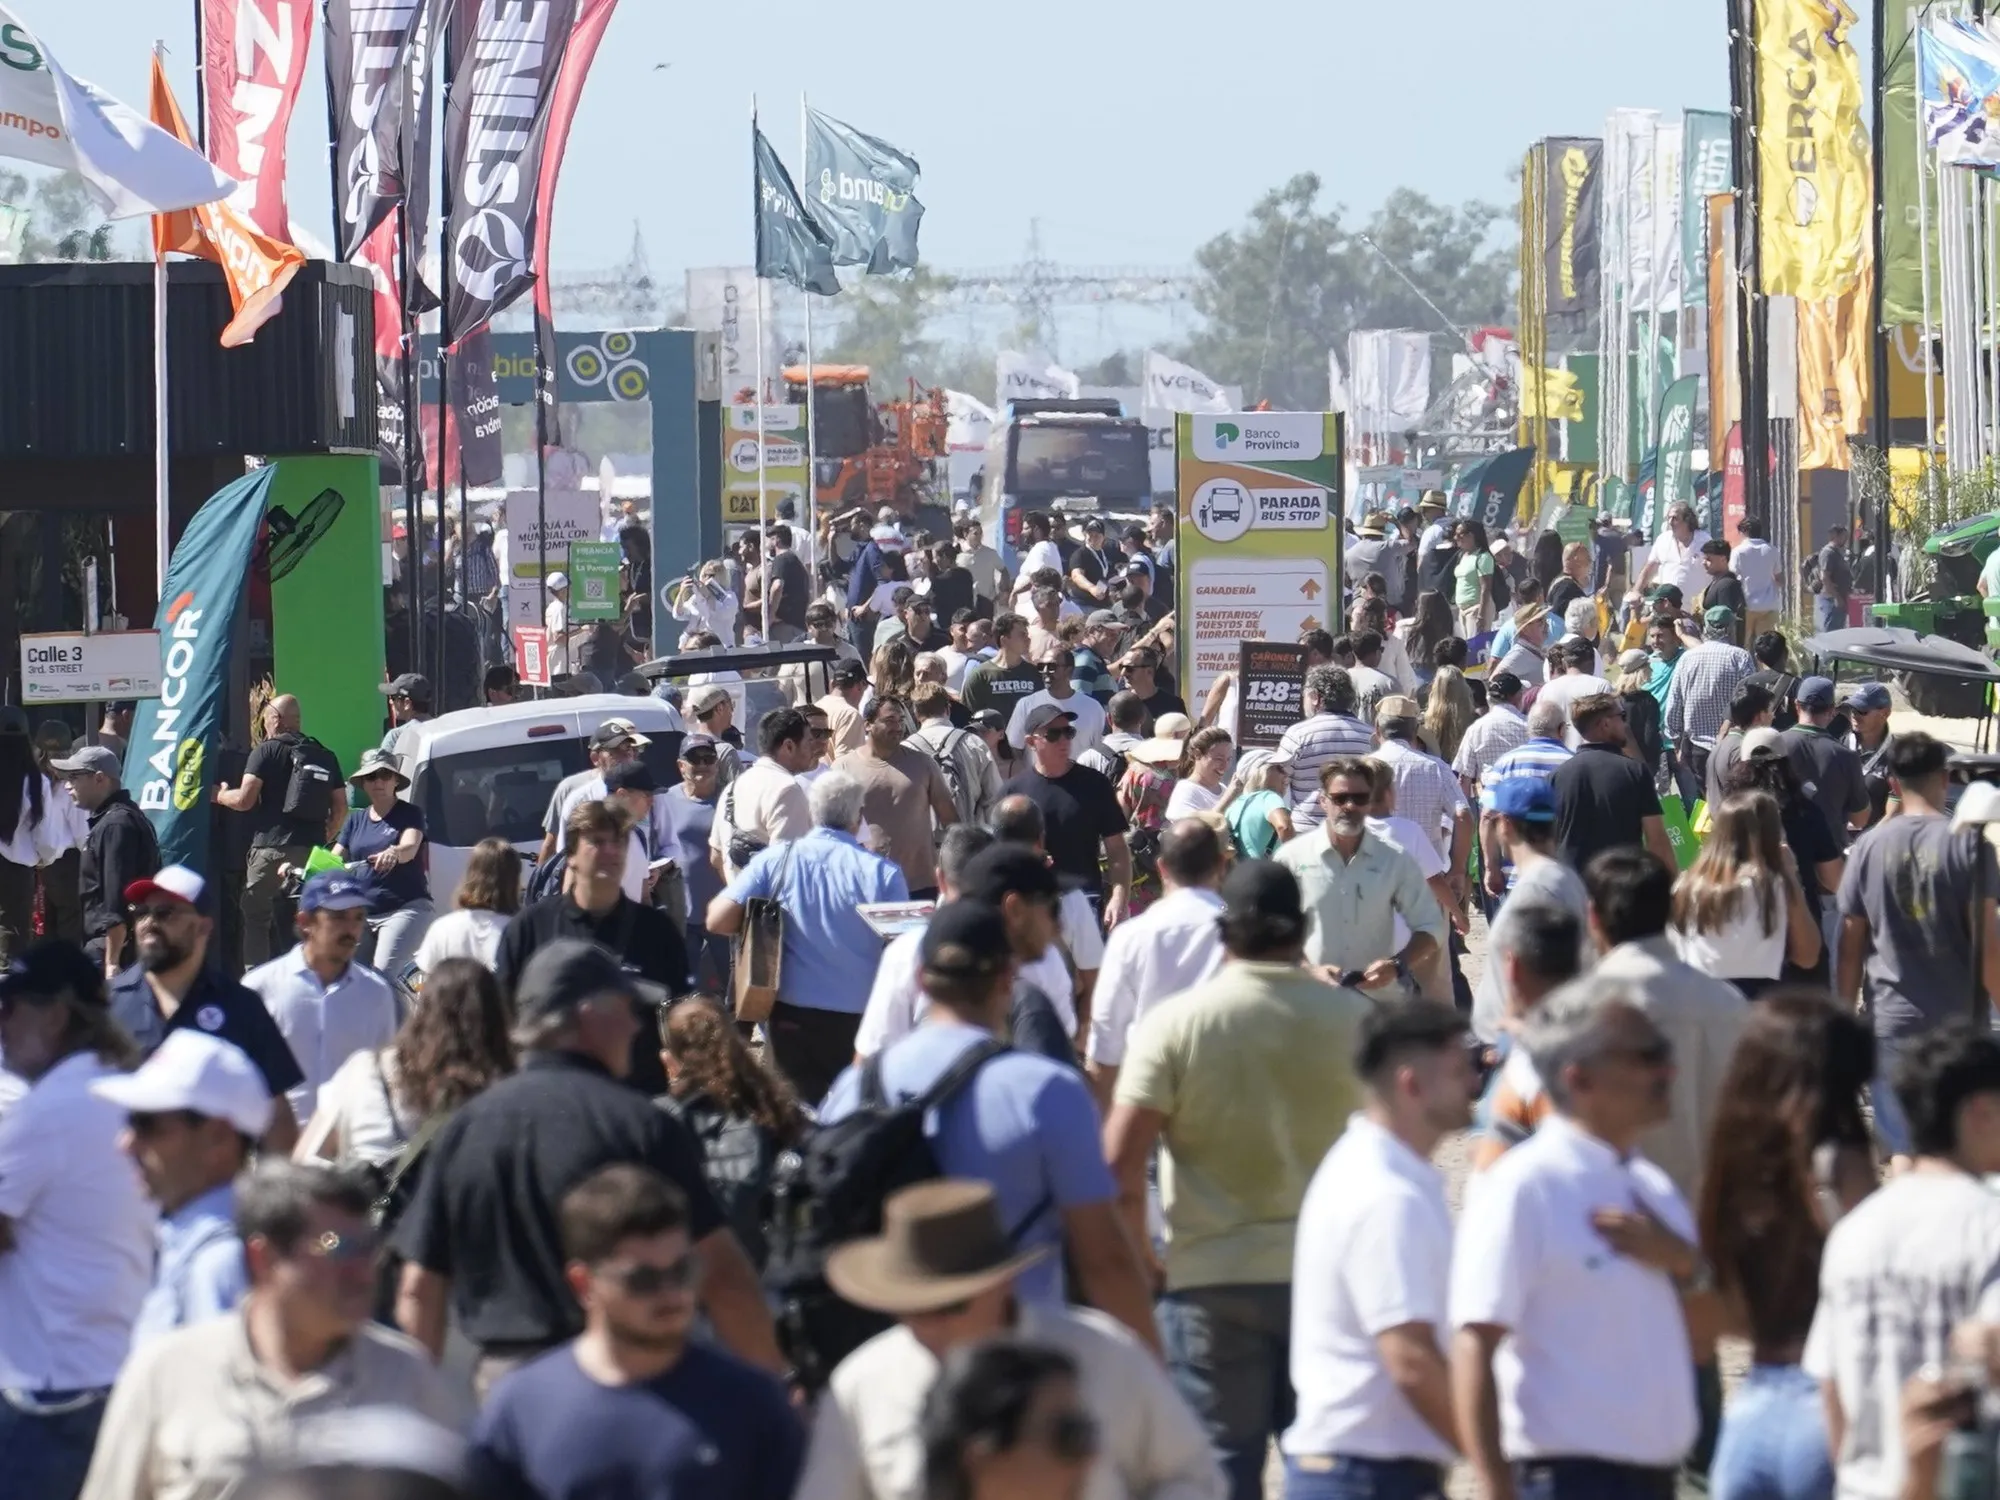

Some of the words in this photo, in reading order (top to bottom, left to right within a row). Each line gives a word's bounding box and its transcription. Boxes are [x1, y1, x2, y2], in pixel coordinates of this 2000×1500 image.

[1245, 429, 1280, 438] Banco
[1245, 440, 1300, 449] Provincia
[730, 496, 757, 513] CAT
[1260, 496, 1321, 508] PARADA
[1261, 510, 1286, 521] BUS
[1289, 510, 1321, 521] STOP
[1196, 584, 1256, 595] GANADERÍA
[1196, 610, 1263, 619] SANITARIOS/
[1196, 620, 1242, 629] PUESTOS
[1246, 620, 1260, 628] DE
[1196, 629, 1266, 639] HIDRATACIÓN
[28, 646, 67, 662] Calle
[72, 646, 83, 660] 3
[1197, 652, 1225, 661] ZONA
[28, 665, 47, 674] 3rd.
[49, 664, 83, 673] STREET
[1246, 681, 1290, 702] 138
[140, 608, 202, 811] BANCOR
[1255, 703, 1275, 711] BOLSA
[1284, 702, 1300, 712] MAÍZ
[180, 745, 199, 802] AGRO
